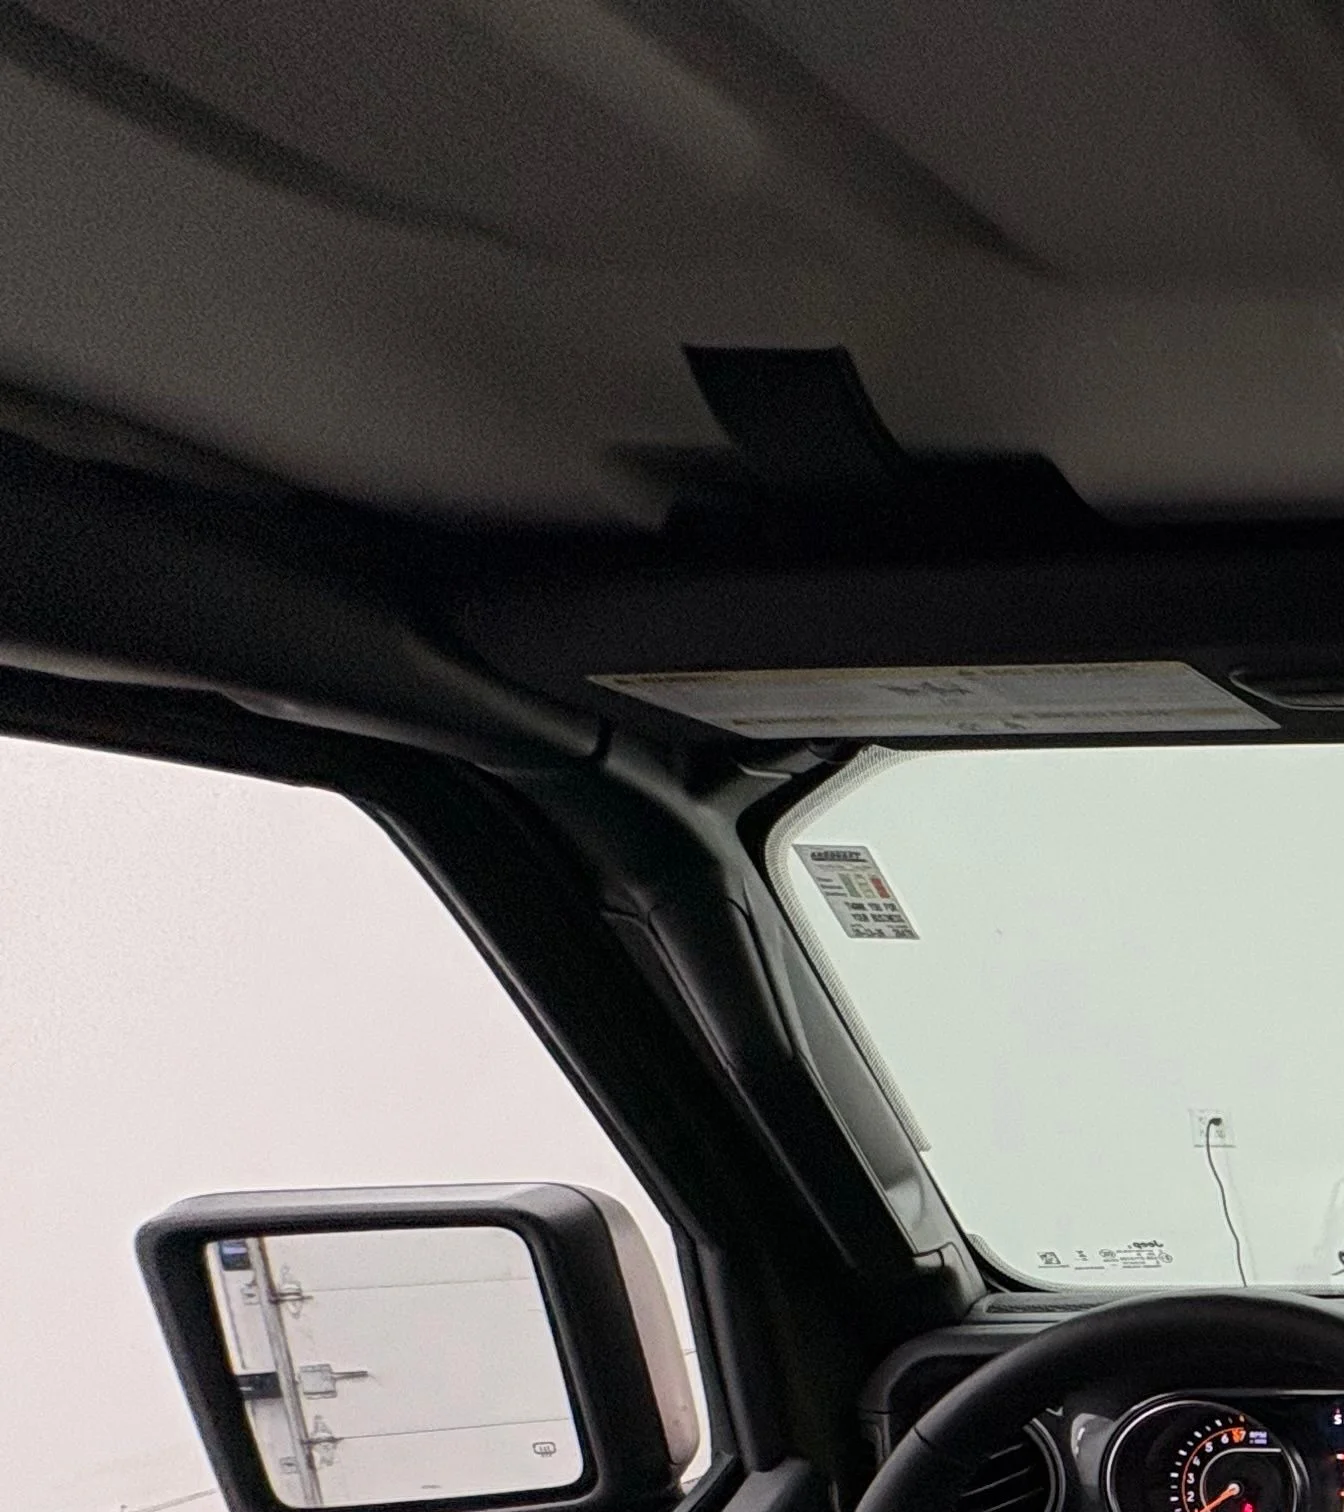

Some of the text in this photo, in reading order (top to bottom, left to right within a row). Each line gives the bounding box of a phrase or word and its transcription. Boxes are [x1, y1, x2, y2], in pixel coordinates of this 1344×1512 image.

[1221, 1434, 1228, 1444] 6
[1204, 1441, 1213, 1453] 5
[1193, 1456, 1200, 1467] 4
[1186, 1473, 1195, 1484] 3
[1186, 1492, 1195, 1502] 2
